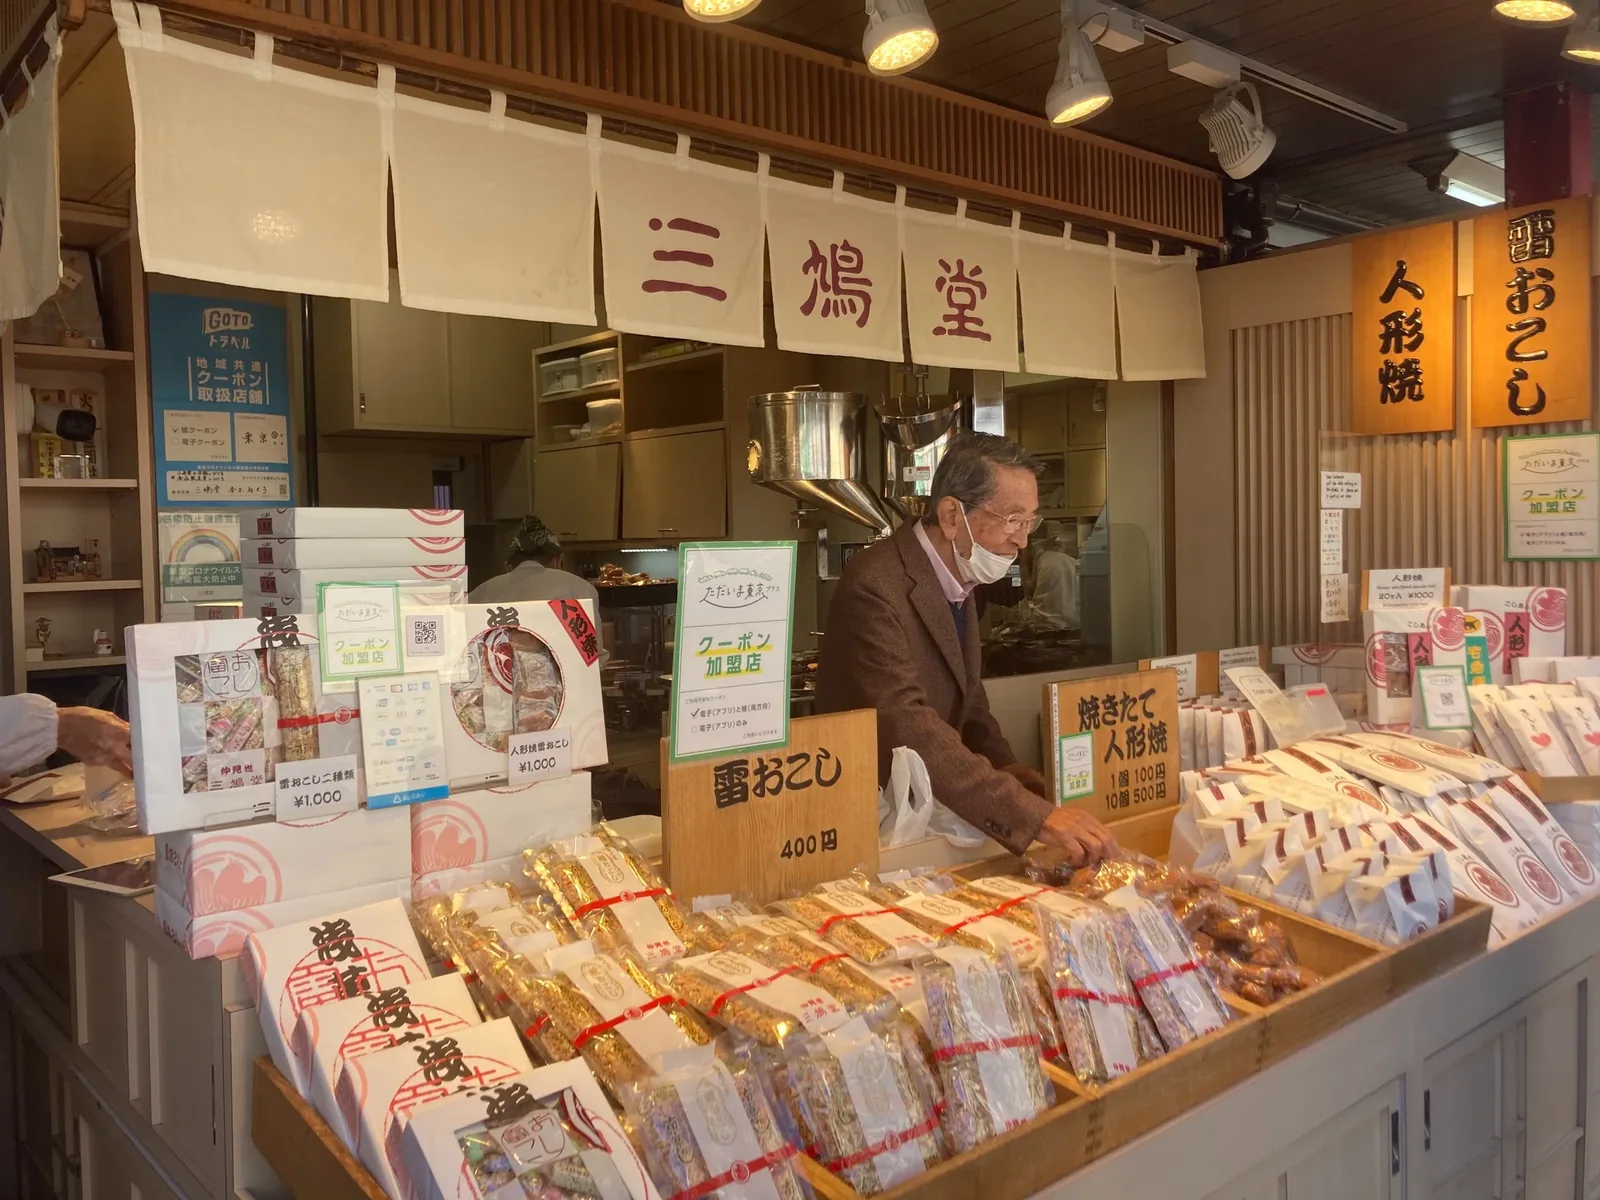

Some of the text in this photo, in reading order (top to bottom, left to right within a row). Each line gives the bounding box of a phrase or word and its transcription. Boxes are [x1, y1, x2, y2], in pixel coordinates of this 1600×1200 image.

[1506, 208, 1556, 416] 雷おこし
[1378, 259, 1425, 405] 人形焼
[209, 334, 250, 349] トラベル
[196, 356, 261, 372] 地域共通
[197, 370, 261, 387] クーポン
[197, 387, 263, 404] 取扱店舗
[1522, 488, 1583, 500] クーポン
[1529, 501, 1576, 514] 加盟店
[705, 583, 767, 599] ただいま東京
[335, 638, 389, 652] クーポン
[698, 632, 771, 655] クーポン
[342, 650, 384, 665] 加盟店
[706, 652, 762, 677] 加盟店
[1078, 688, 1156, 732] 焼きたて
[510, 738, 569, 756] 人形焼雷おこし
[1104, 720, 1168, 764] 人形焼
[519, 757, 556, 773] ¥1,000
[279, 769, 355, 791] 雷おこし二種類
[713, 748, 842, 809] 雷おこし
[1110, 762, 1166, 789] 1個 100円
[293, 790, 342, 808] ¥1,000
[1105, 781, 1166, 810] 10個 500円
[780, 828, 838, 859] 400円
